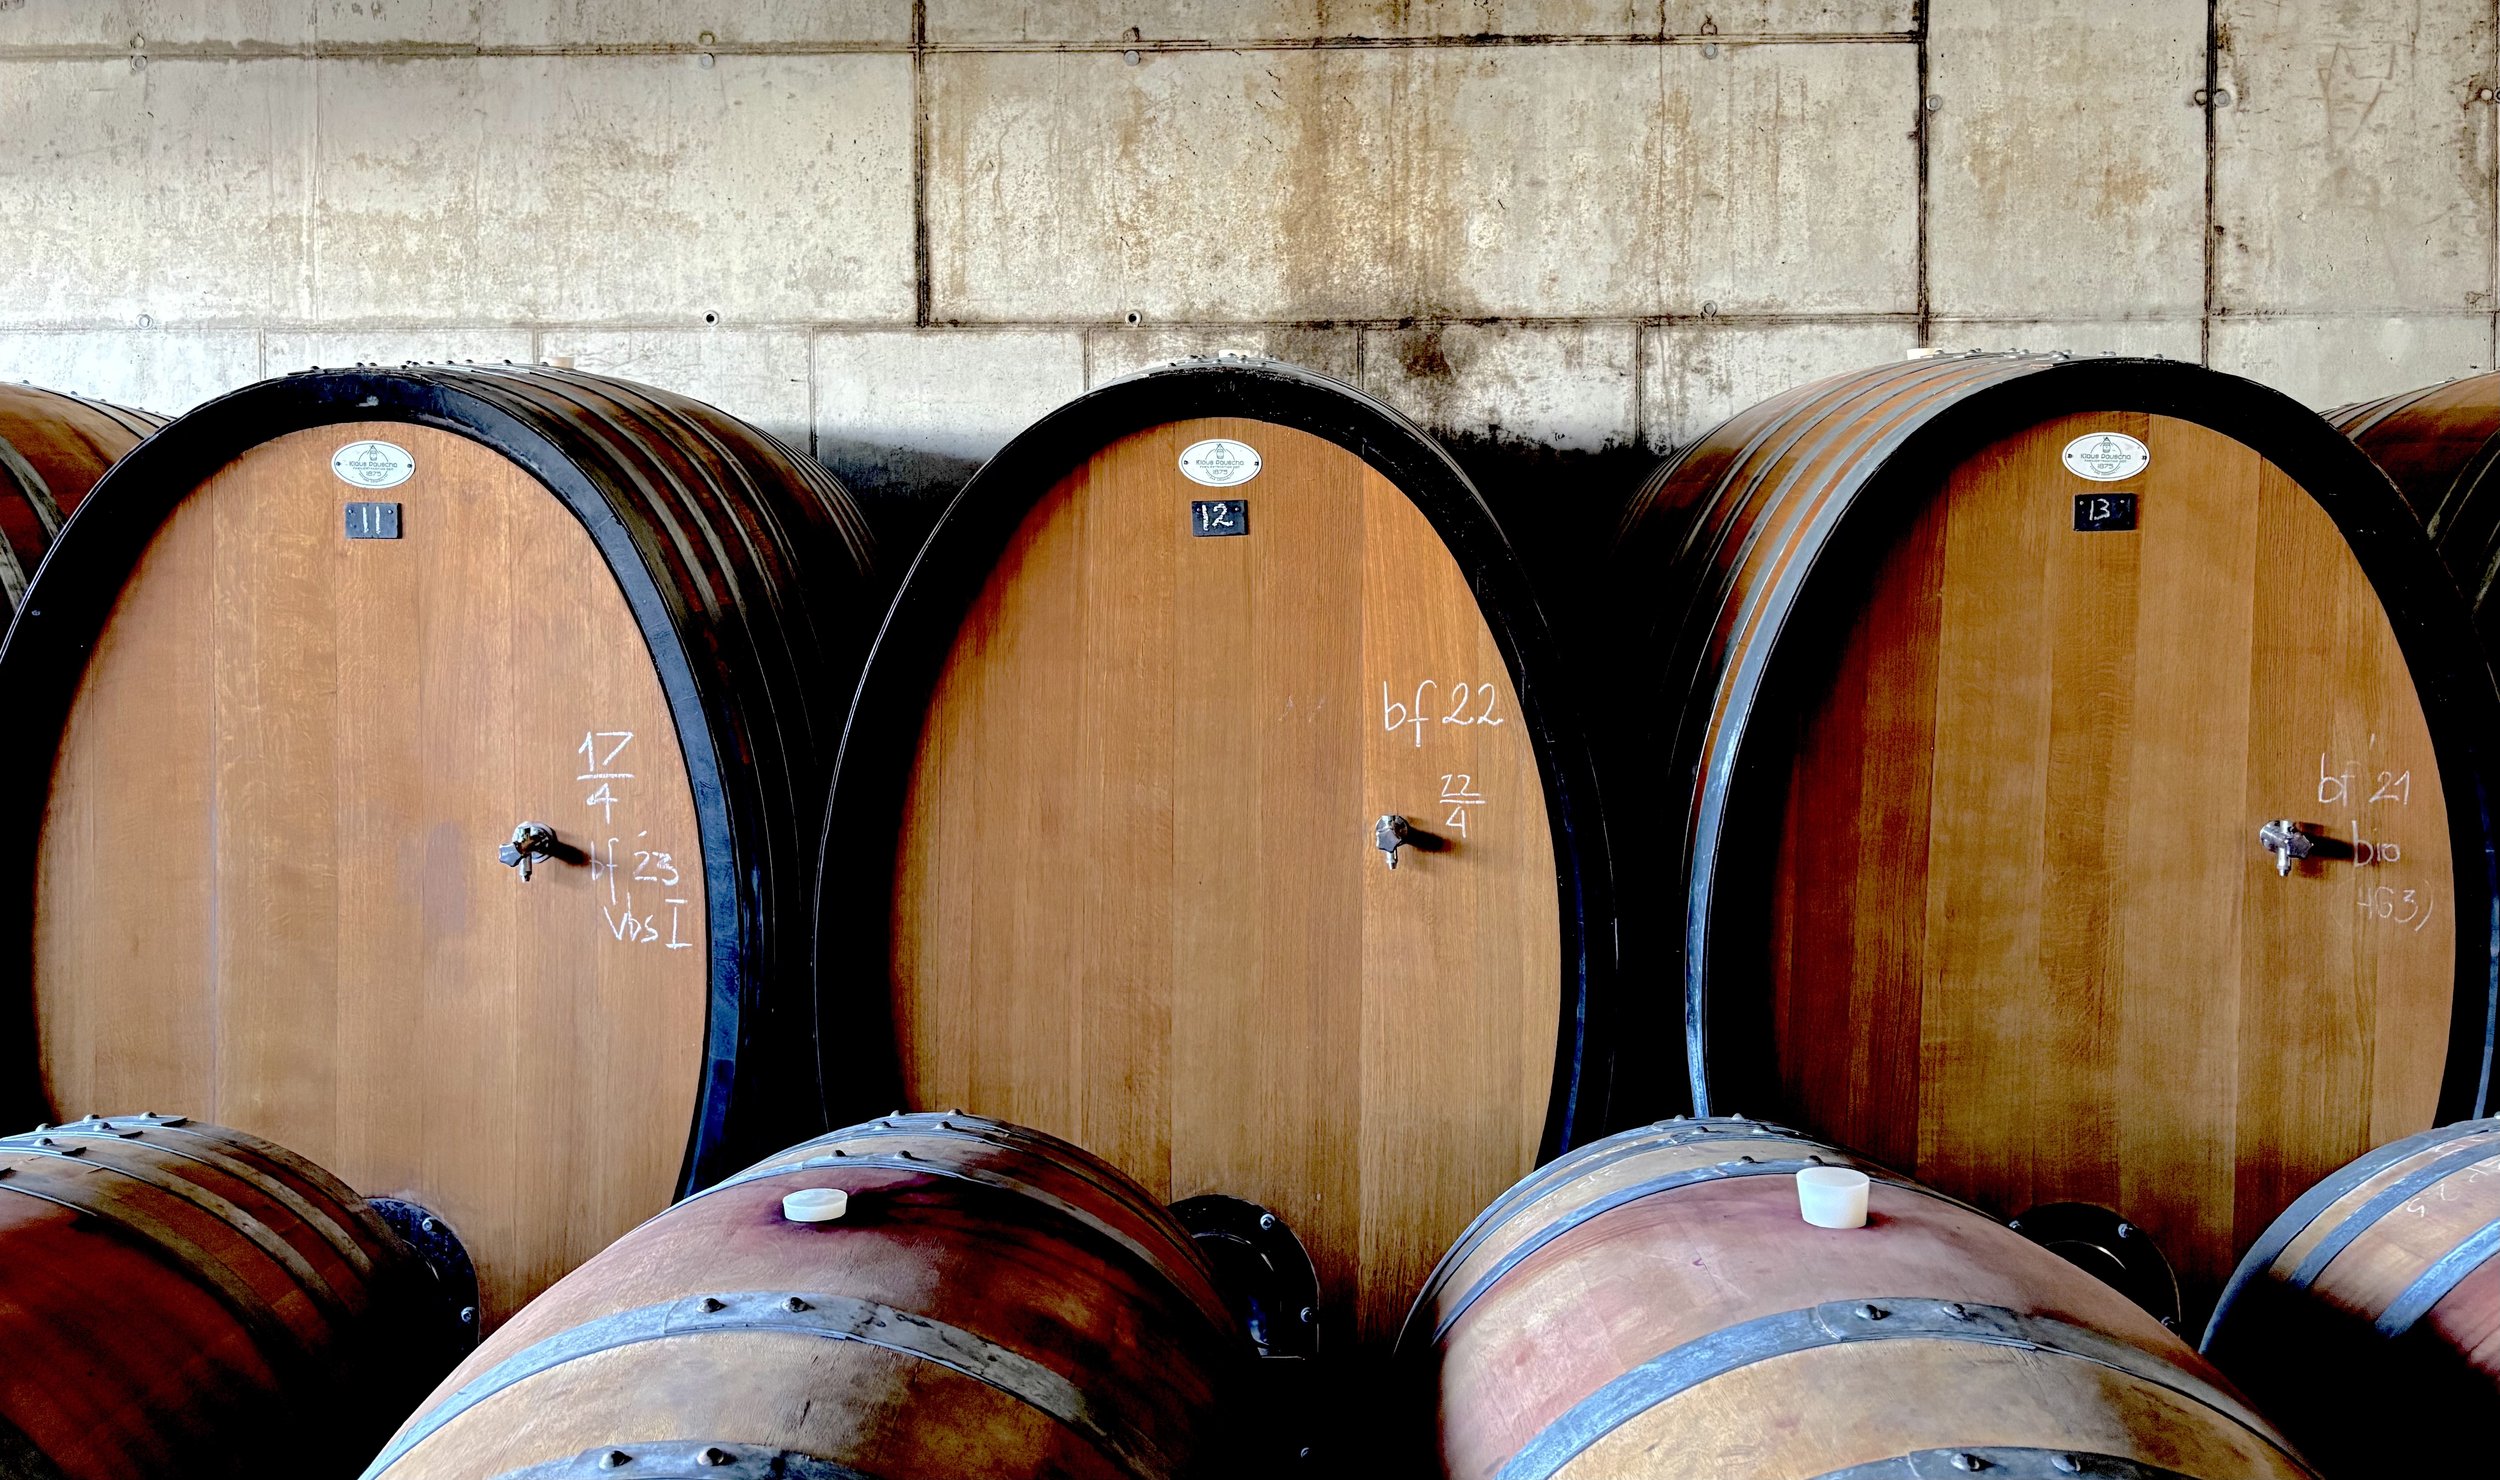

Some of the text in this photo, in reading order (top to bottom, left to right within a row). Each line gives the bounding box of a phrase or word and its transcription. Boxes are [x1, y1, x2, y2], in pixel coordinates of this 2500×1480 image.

[362, 505, 381, 535] 11
[1202, 503, 1234, 531] 12
[2088, 498, 2111, 521] 13
[1384, 679, 1504, 748] bf 22
[578, 730, 635, 772] 17
[586, 782, 619, 825] 4
[1440, 773, 1482, 798] 22
[1445, 804, 1468, 840] 4
[2351, 819, 2401, 869] bio
